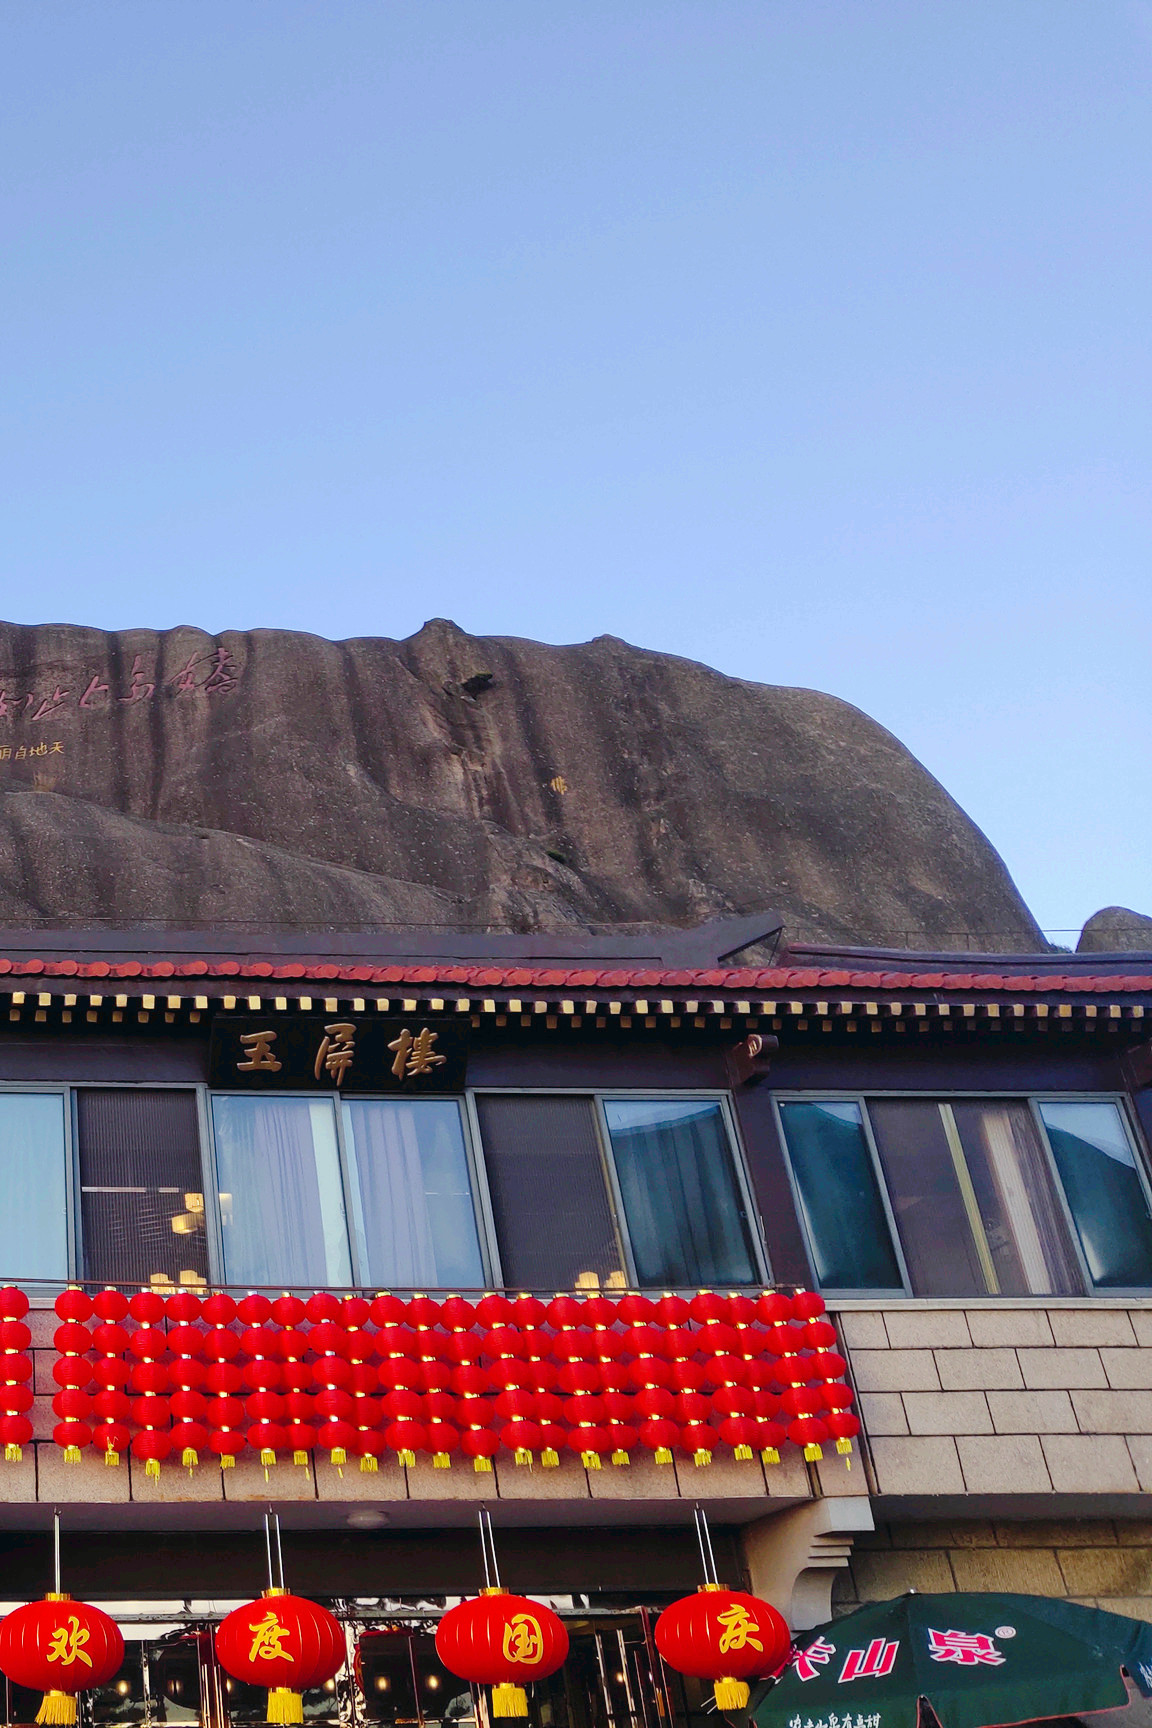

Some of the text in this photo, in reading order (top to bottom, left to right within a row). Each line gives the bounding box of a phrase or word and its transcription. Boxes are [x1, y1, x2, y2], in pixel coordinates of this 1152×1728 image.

[46, 1615, 93, 1668] 欢
[248, 1611, 294, 1663] 度
[502, 1613, 544, 1664] 国
[717, 1603, 764, 1654] 庆
